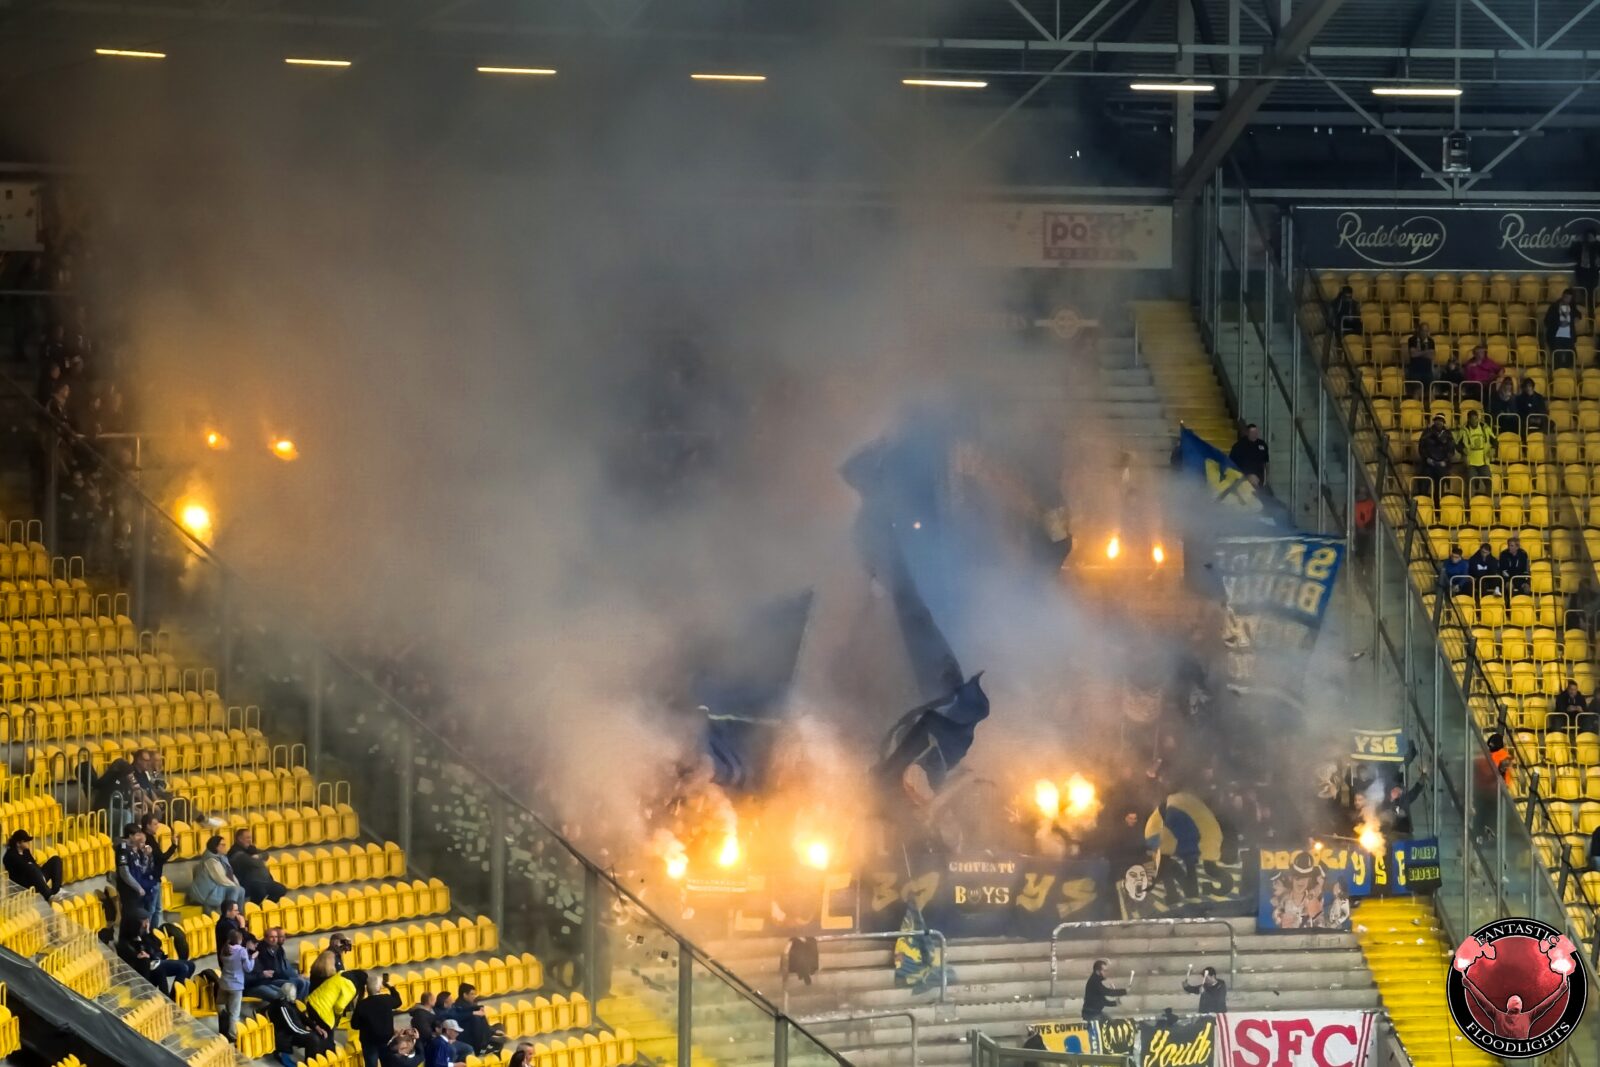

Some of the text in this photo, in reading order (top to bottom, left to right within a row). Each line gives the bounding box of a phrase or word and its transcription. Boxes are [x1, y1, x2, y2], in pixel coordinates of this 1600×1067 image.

[1336, 212, 1440, 254] Radeberger
[1144, 1022, 1211, 1067] Youth
[1233, 1018, 1357, 1067] SFC
